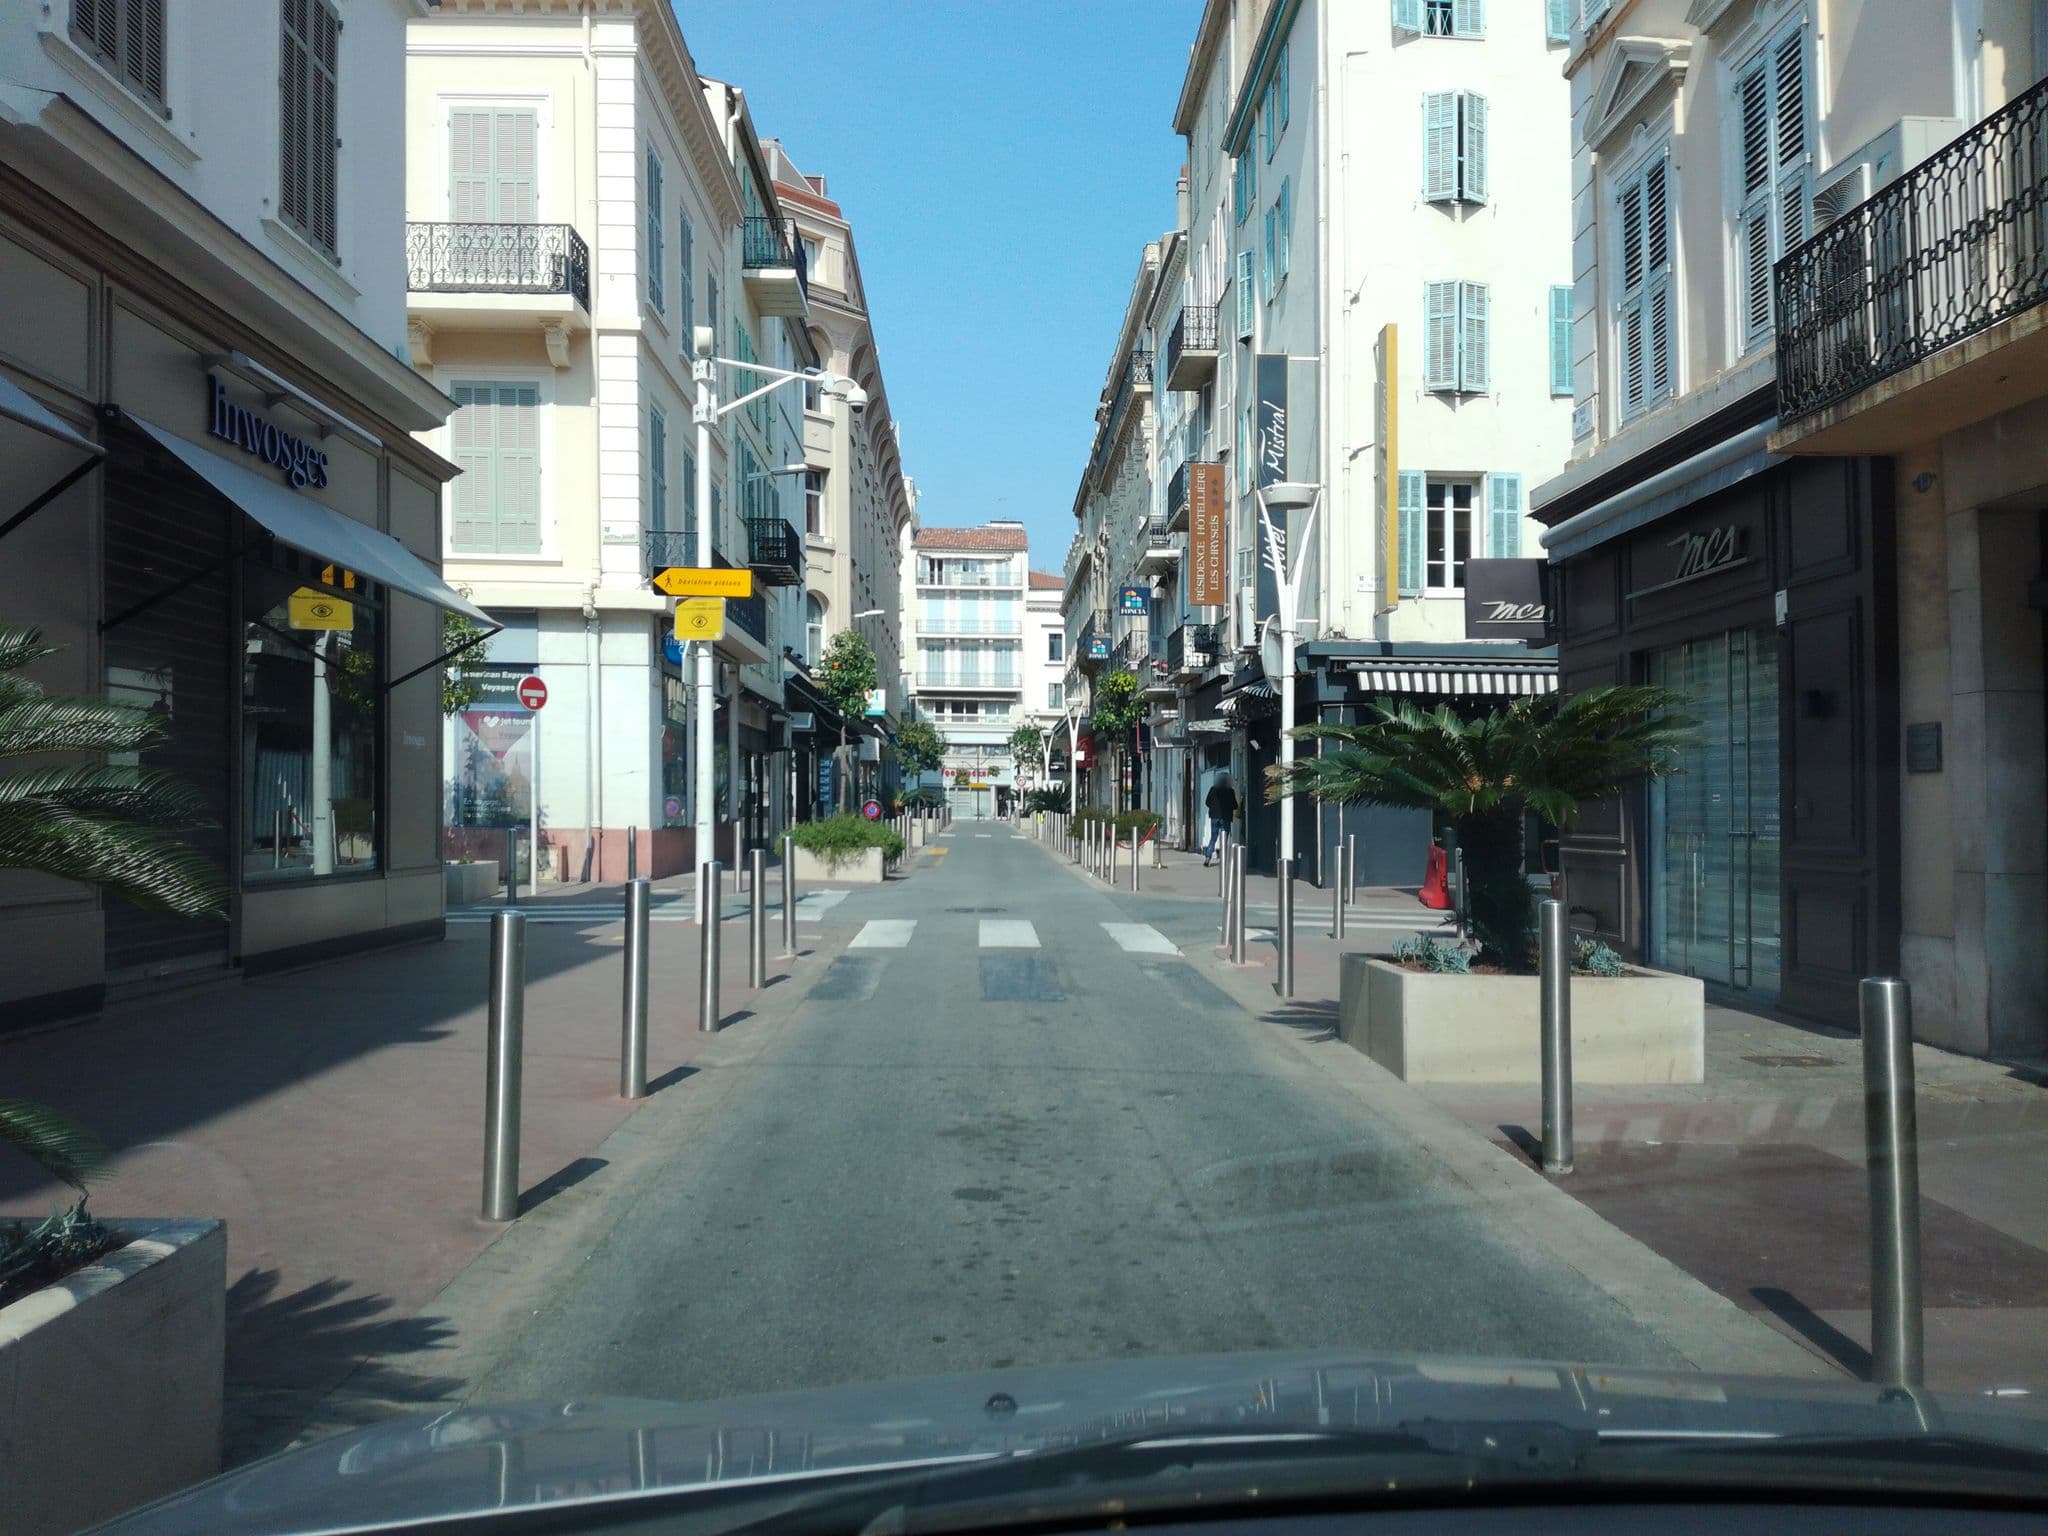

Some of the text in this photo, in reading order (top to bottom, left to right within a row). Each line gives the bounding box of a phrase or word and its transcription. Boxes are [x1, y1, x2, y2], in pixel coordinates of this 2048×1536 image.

[1262, 400, 1286, 474] Mistral
[1210, 570, 1219, 591] LES
[463, 669, 500, 679] American
[482, 684, 515, 693] Voyages
